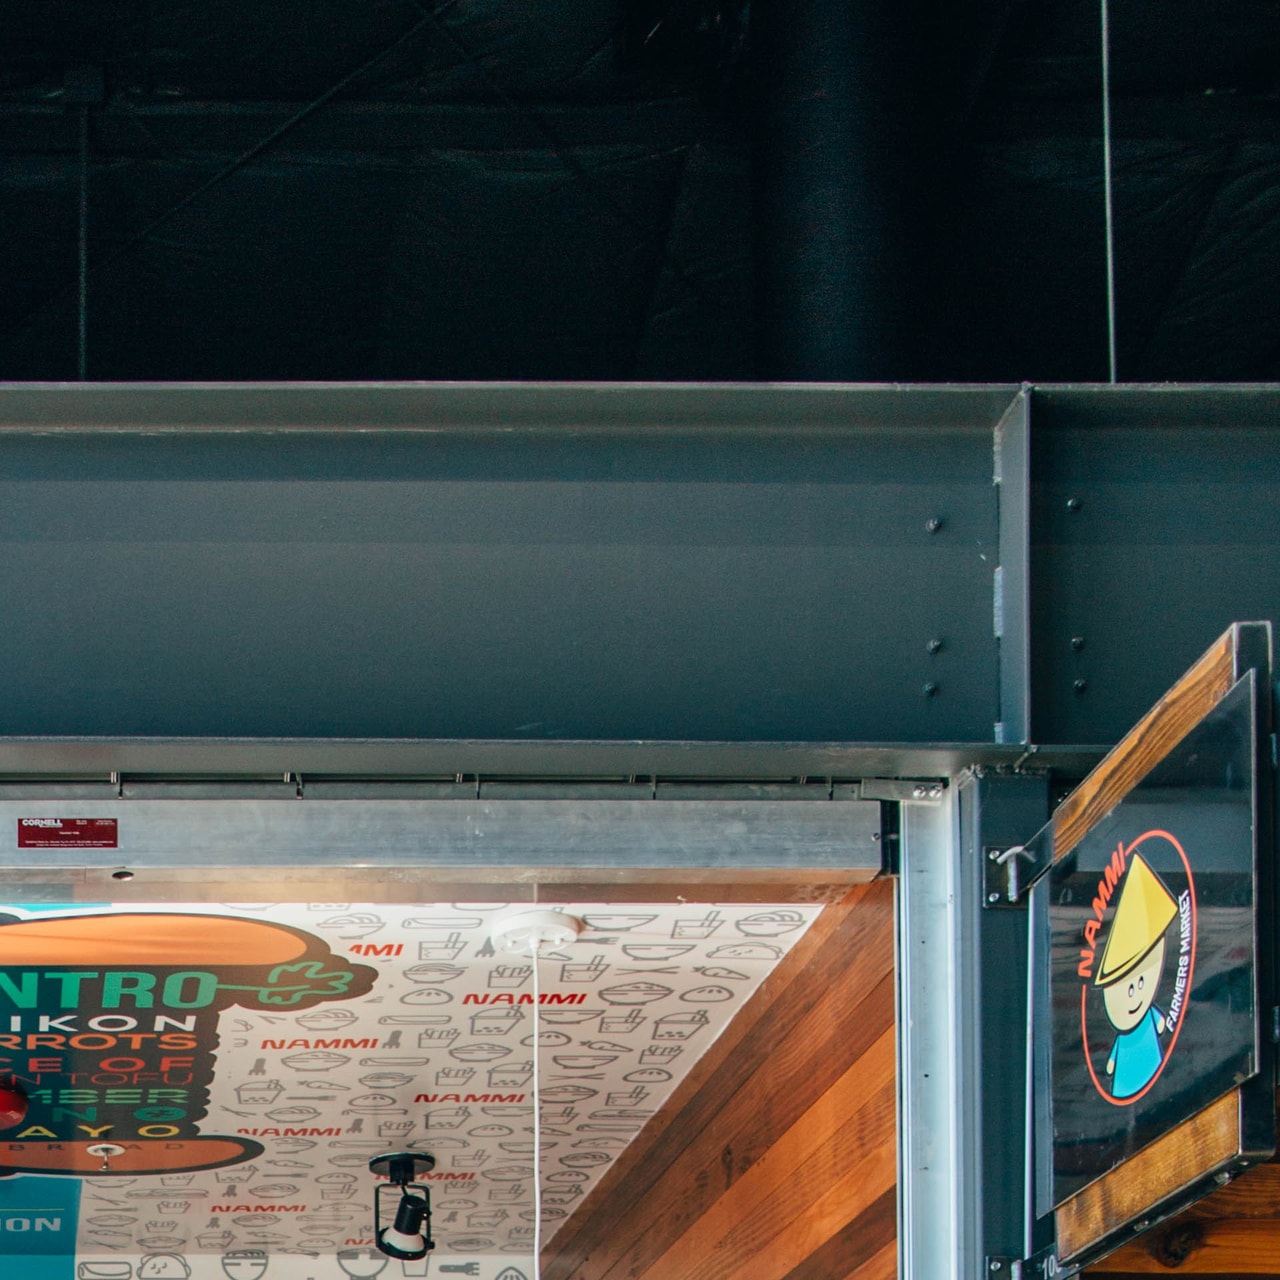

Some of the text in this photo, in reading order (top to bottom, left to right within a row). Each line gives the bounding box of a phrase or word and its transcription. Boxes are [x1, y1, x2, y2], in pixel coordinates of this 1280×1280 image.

[1077, 842, 1126, 978] NAMMI
[1165, 889, 1191, 1033] FARMERS MARKET
[463, 993, 587, 1006] NAMMI
[261, 1038, 379, 1050] NAMMI
[98, 1057, 196, 1074] OF
[59, 1072, 195, 1086] TOFU
[414, 1092, 526, 1103] NAMMI
[210, 1204, 307, 1213] NAMMI
